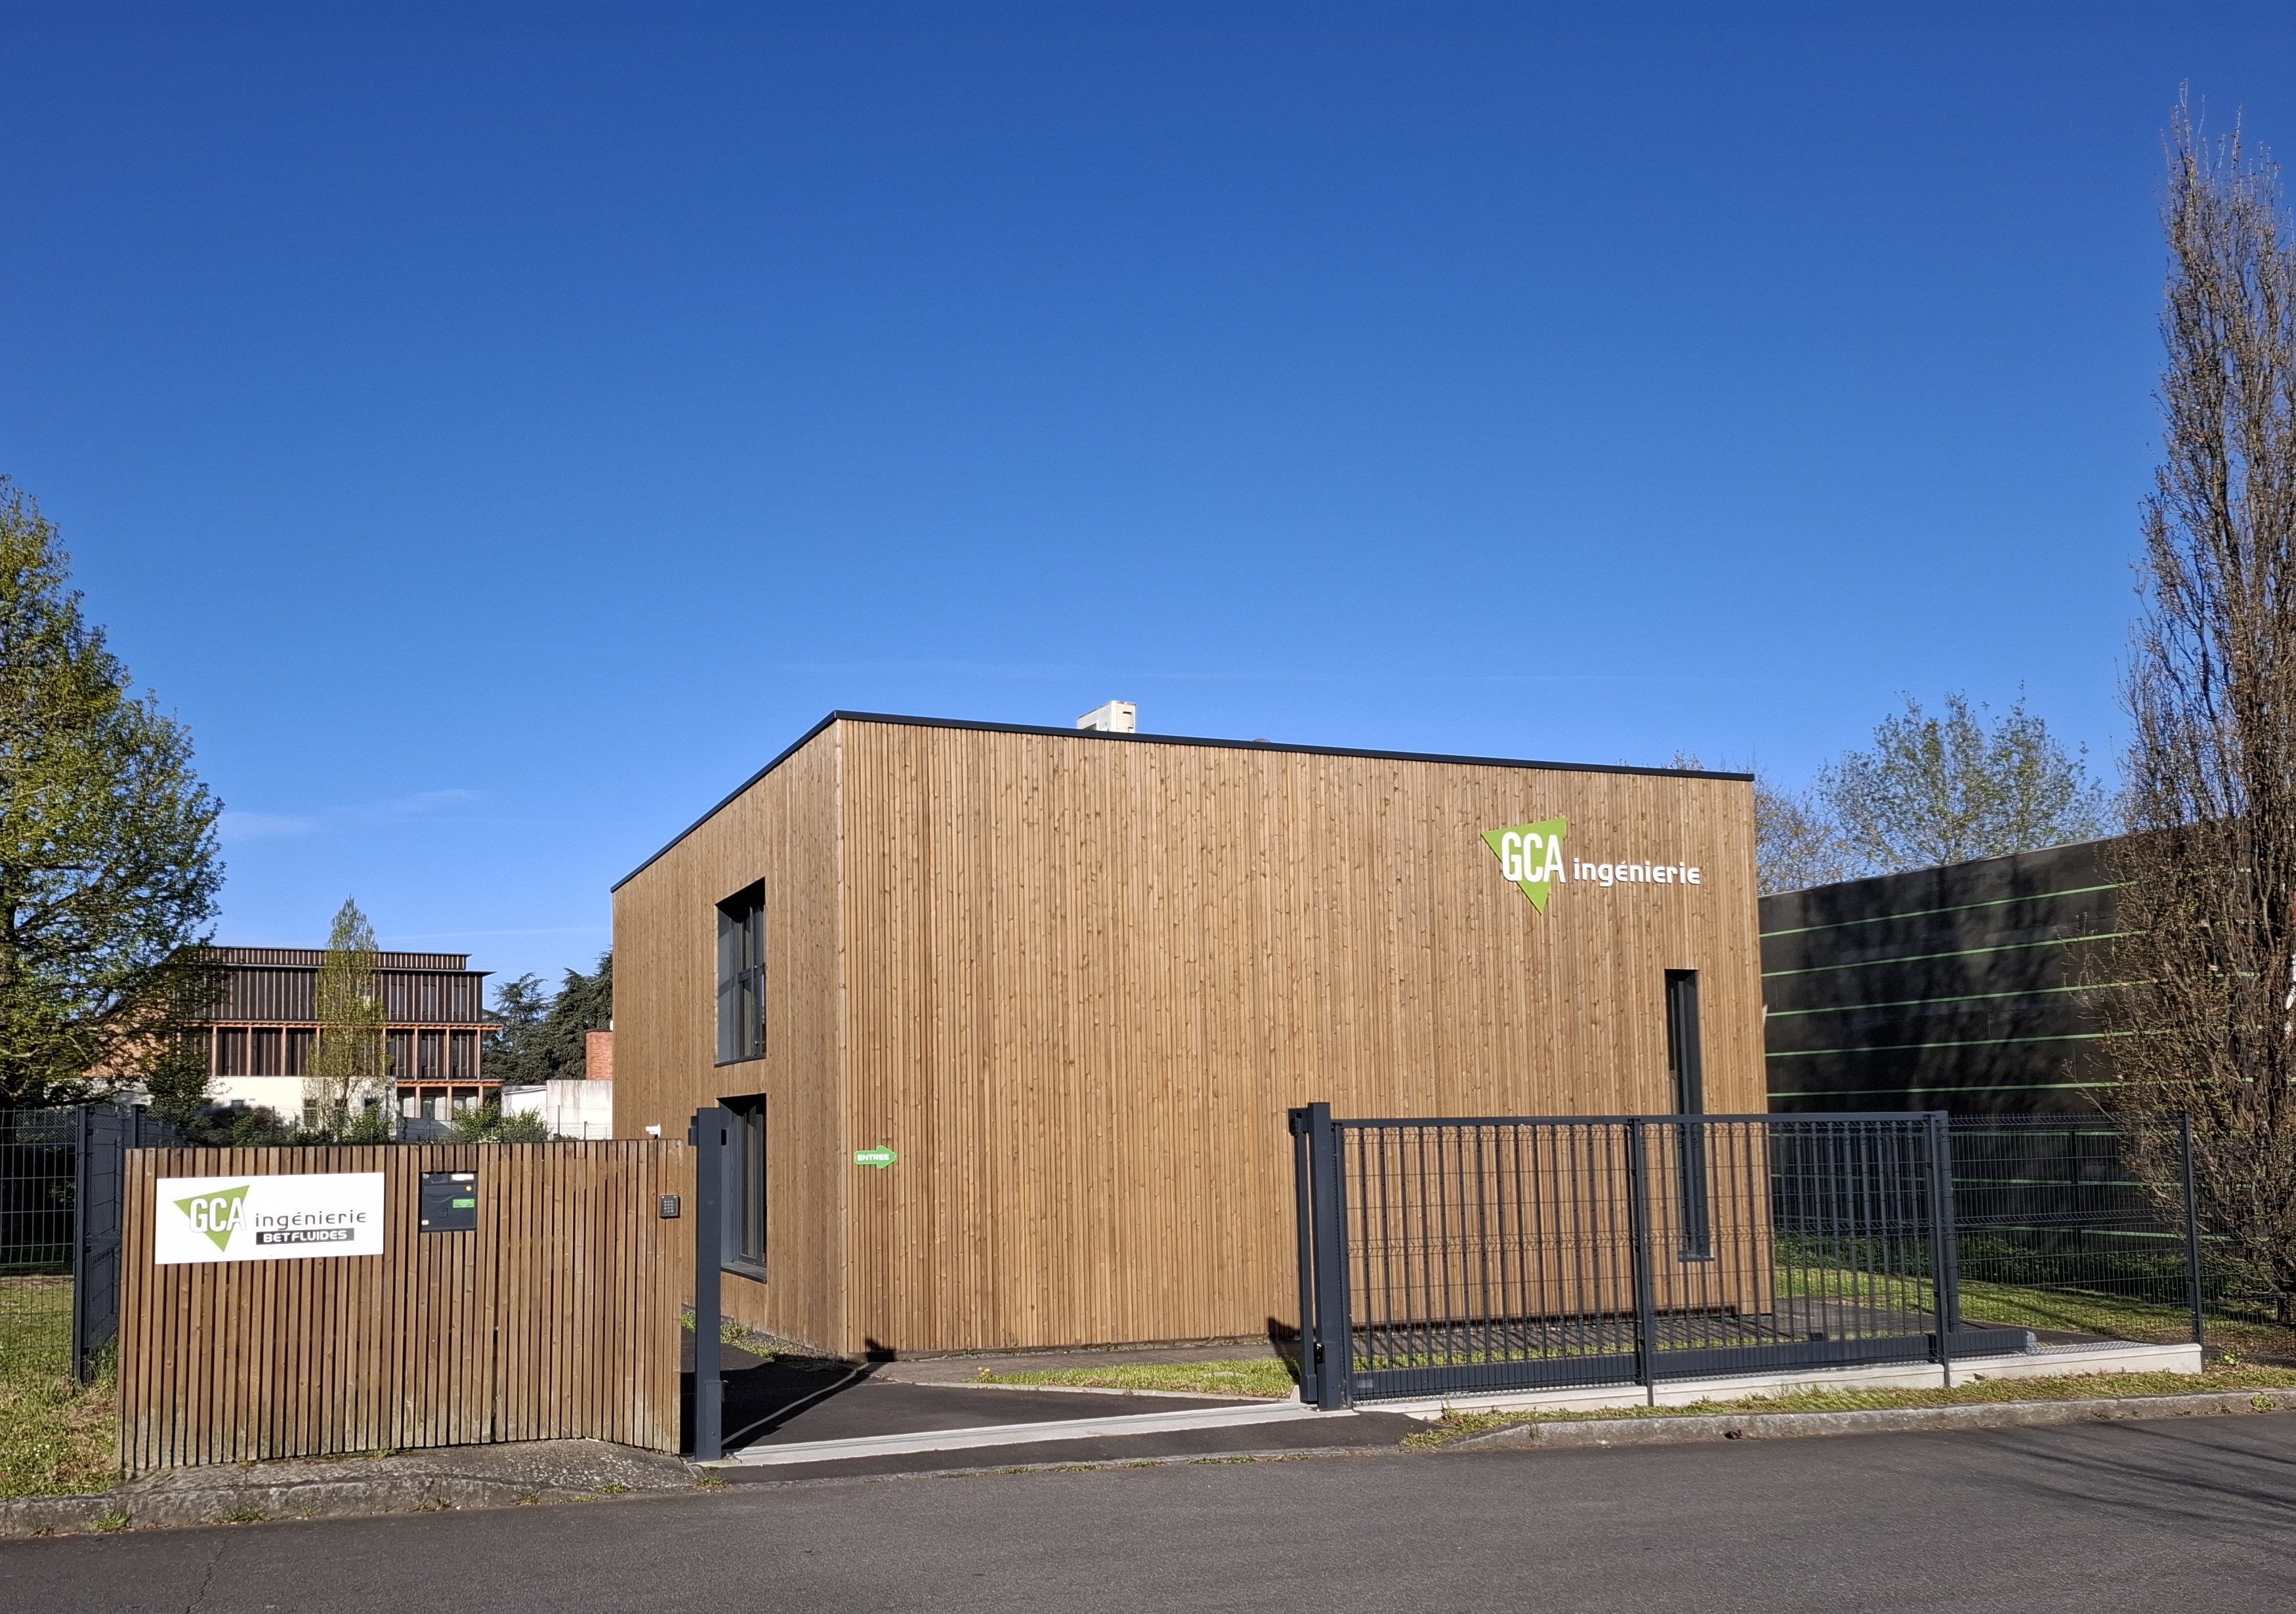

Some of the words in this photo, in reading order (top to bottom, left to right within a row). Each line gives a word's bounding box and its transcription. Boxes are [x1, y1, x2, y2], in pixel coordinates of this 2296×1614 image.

[1501, 831, 1566, 883] GCA
[1574, 858, 1700, 887] ingénierie
[189, 1197, 247, 1233] GCA
[255, 1209, 367, 1231] ingénierie
